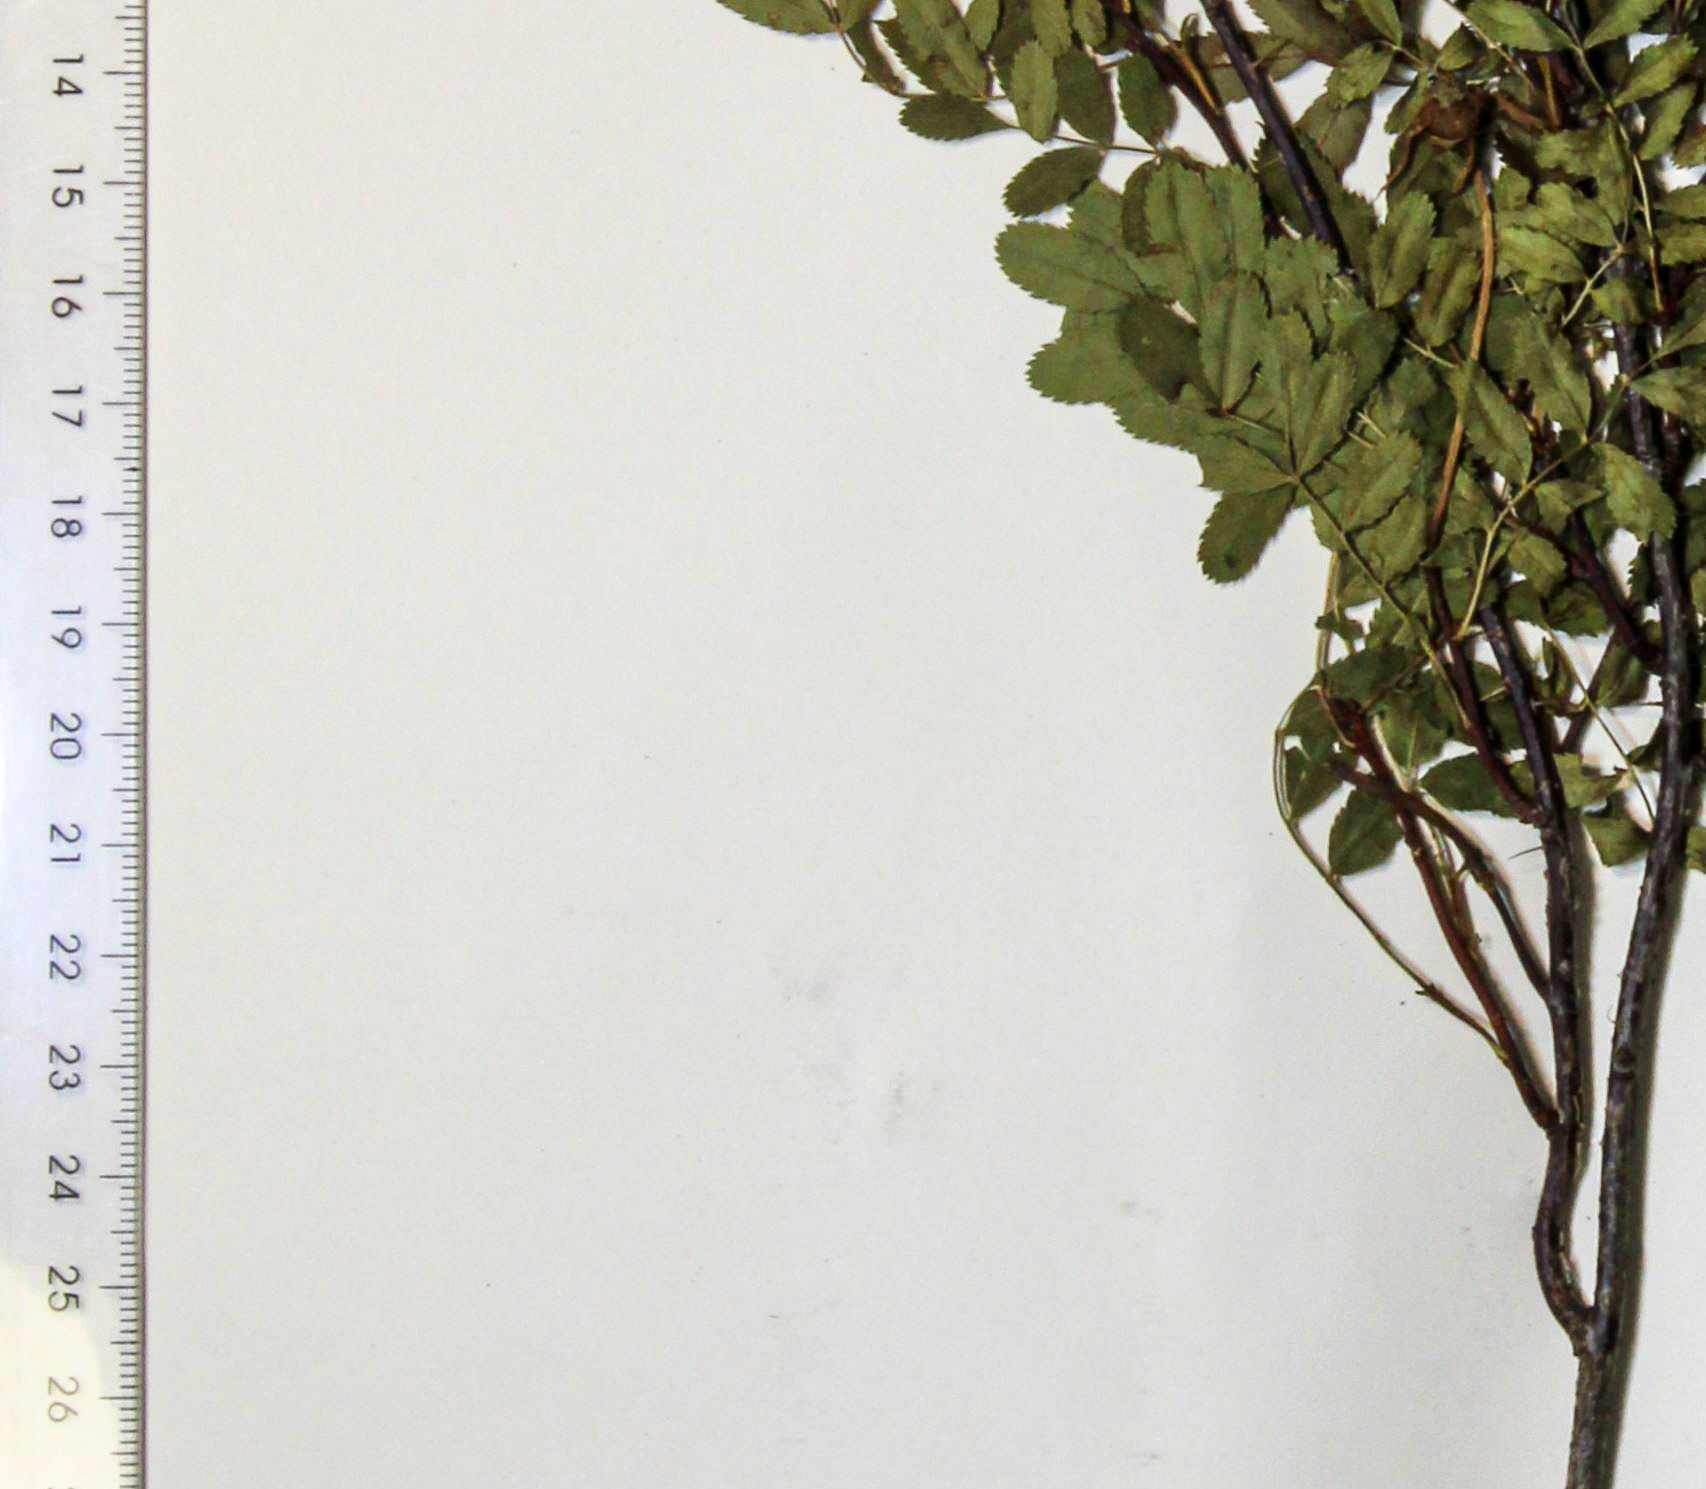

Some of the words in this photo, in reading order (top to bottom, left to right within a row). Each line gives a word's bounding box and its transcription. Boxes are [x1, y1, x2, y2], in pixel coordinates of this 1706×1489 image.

[52, 54, 85, 97] 14
[51, 164, 85, 209] 15
[51, 274, 85, 319] 16
[51, 385, 84, 428] 17
[50, 495, 84, 539] 18
[50, 605, 83, 650] 19
[49, 712, 83, 761] 20
[49, 823, 82, 863] 21
[49, 934, 82, 981] 22
[48, 1044, 82, 1091] 23
[48, 1154, 82, 1201] 24
[48, 1265, 81, 1312] 25
[47, 1376, 80, 1423] 26
